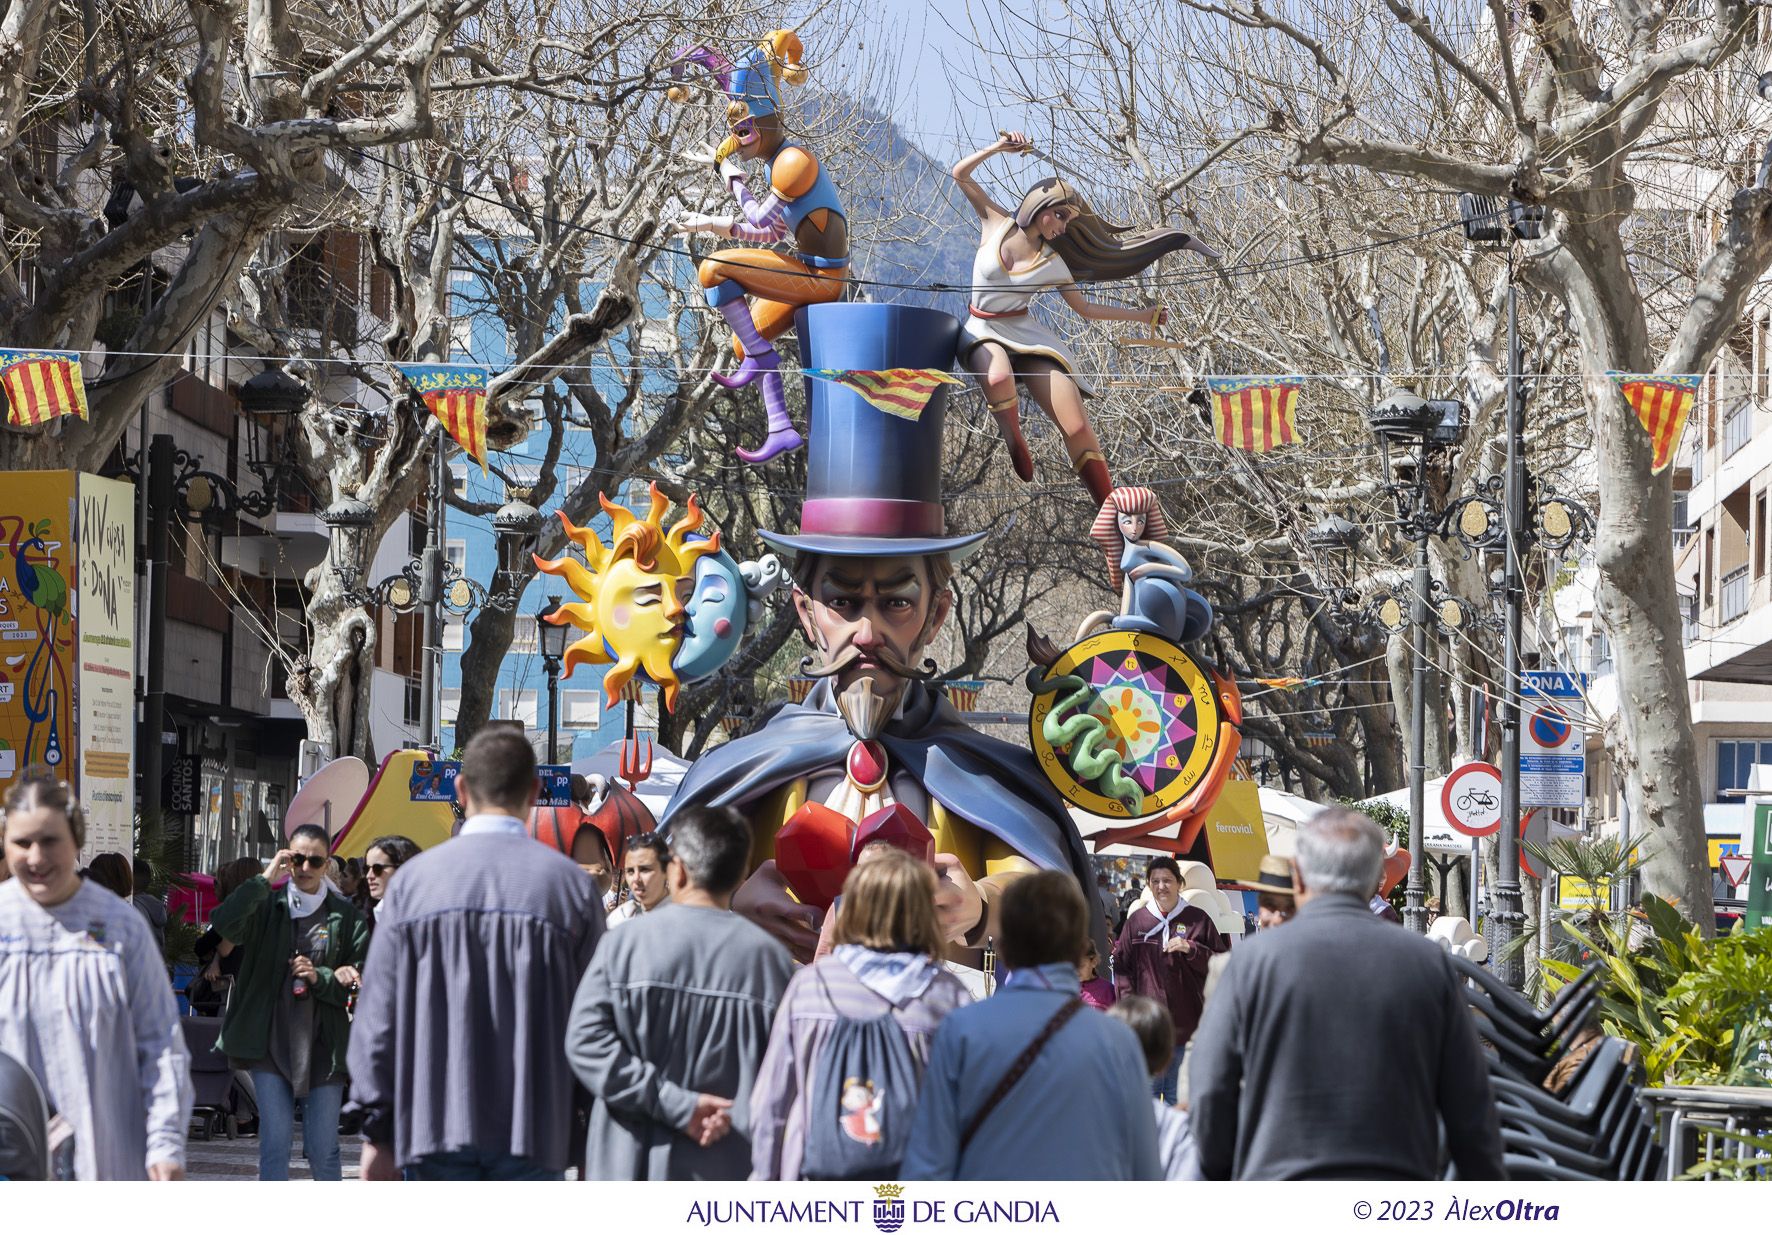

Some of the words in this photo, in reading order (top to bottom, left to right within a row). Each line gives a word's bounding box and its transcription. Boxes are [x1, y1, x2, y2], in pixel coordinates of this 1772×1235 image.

[83, 493, 108, 558] XIV
[172, 759, 181, 811] COCINAS
[182, 759, 193, 811] SANTOS
